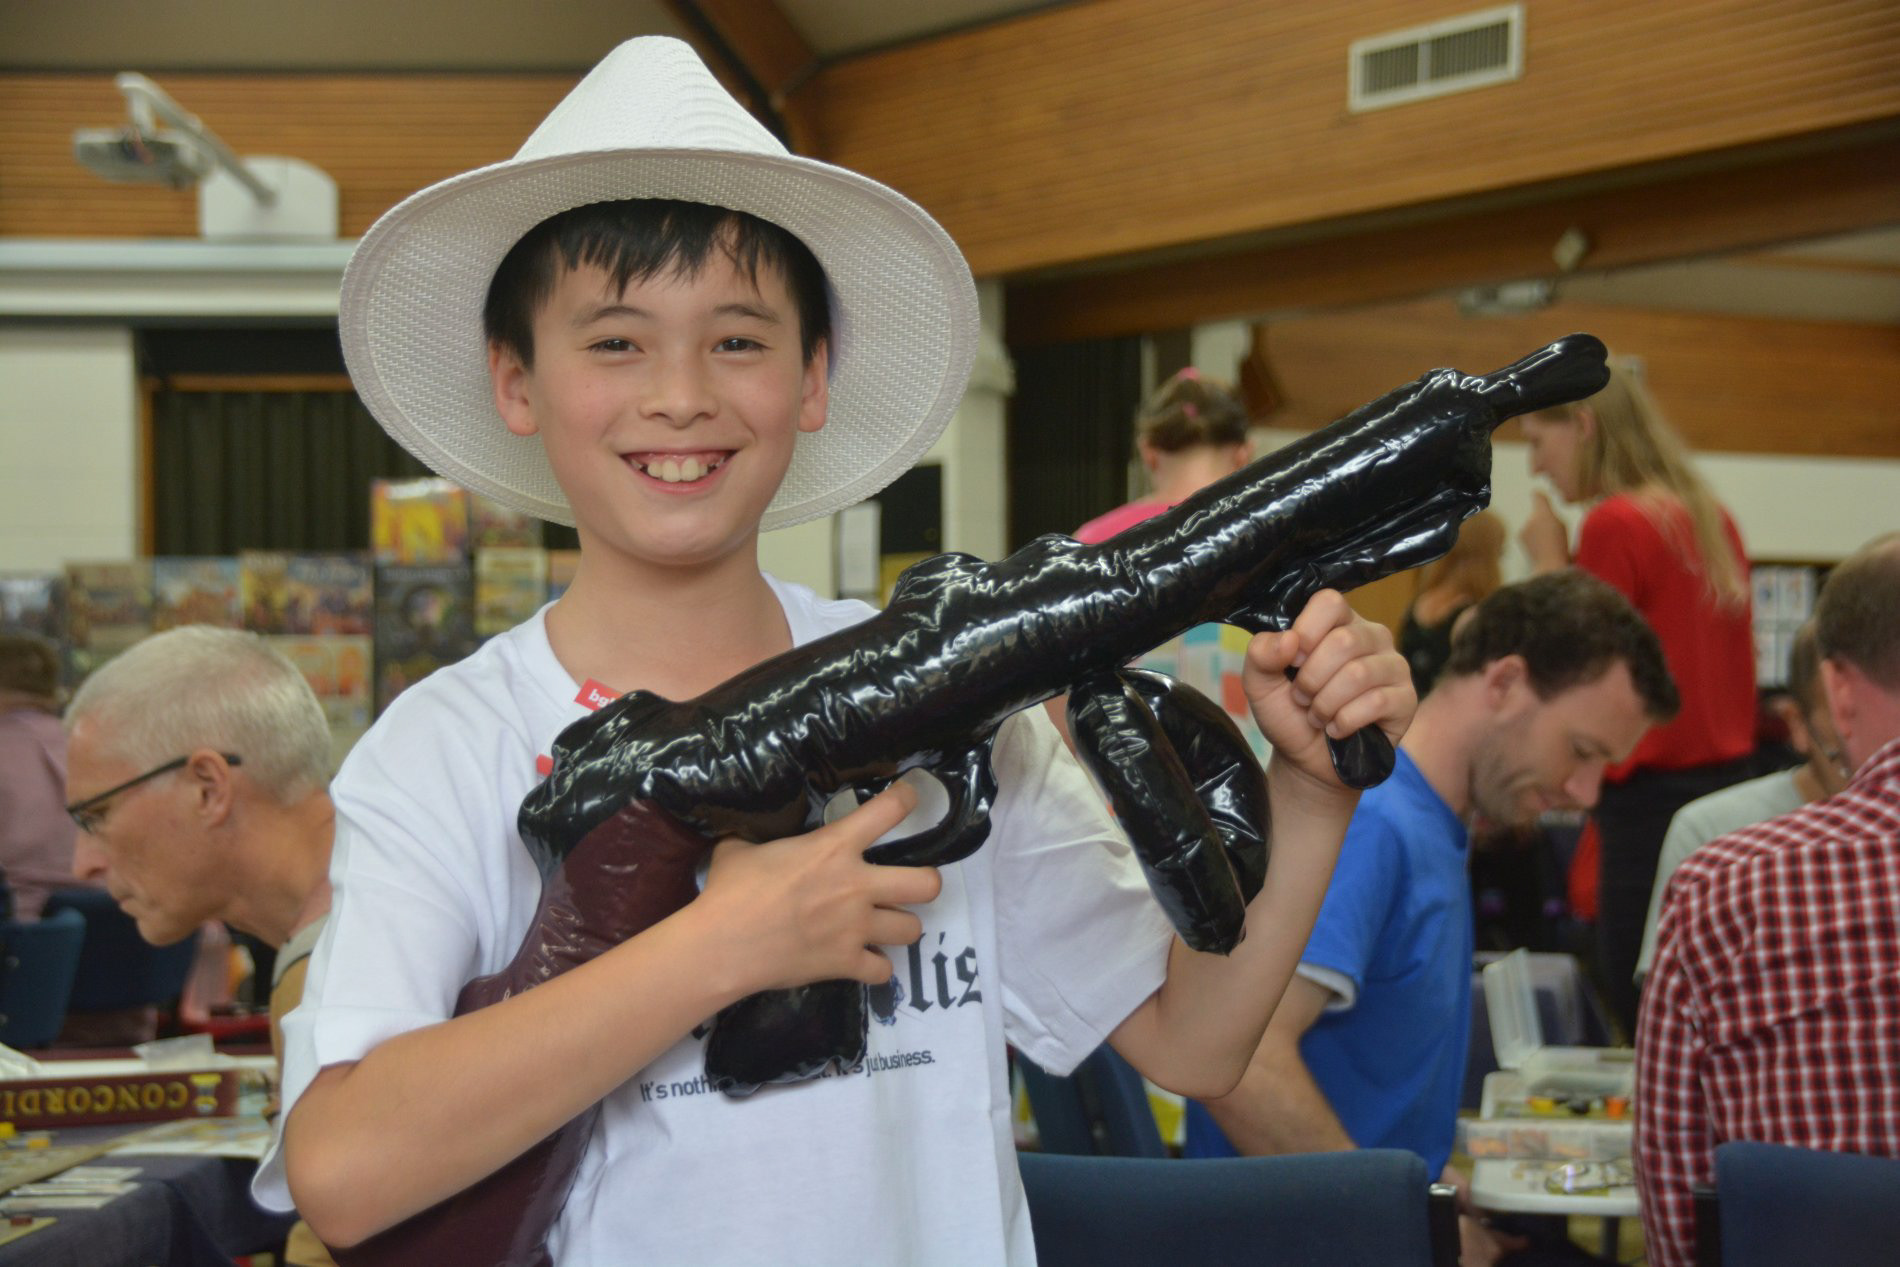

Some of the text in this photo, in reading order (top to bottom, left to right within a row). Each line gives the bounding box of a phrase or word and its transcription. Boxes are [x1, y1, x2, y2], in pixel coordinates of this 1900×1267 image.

[640, 1081, 668, 1102] It's
[671, 1075, 723, 1098] noth
[880, 1049, 936, 1071] business.
[0, 1080, 189, 1117] CONCORDI
